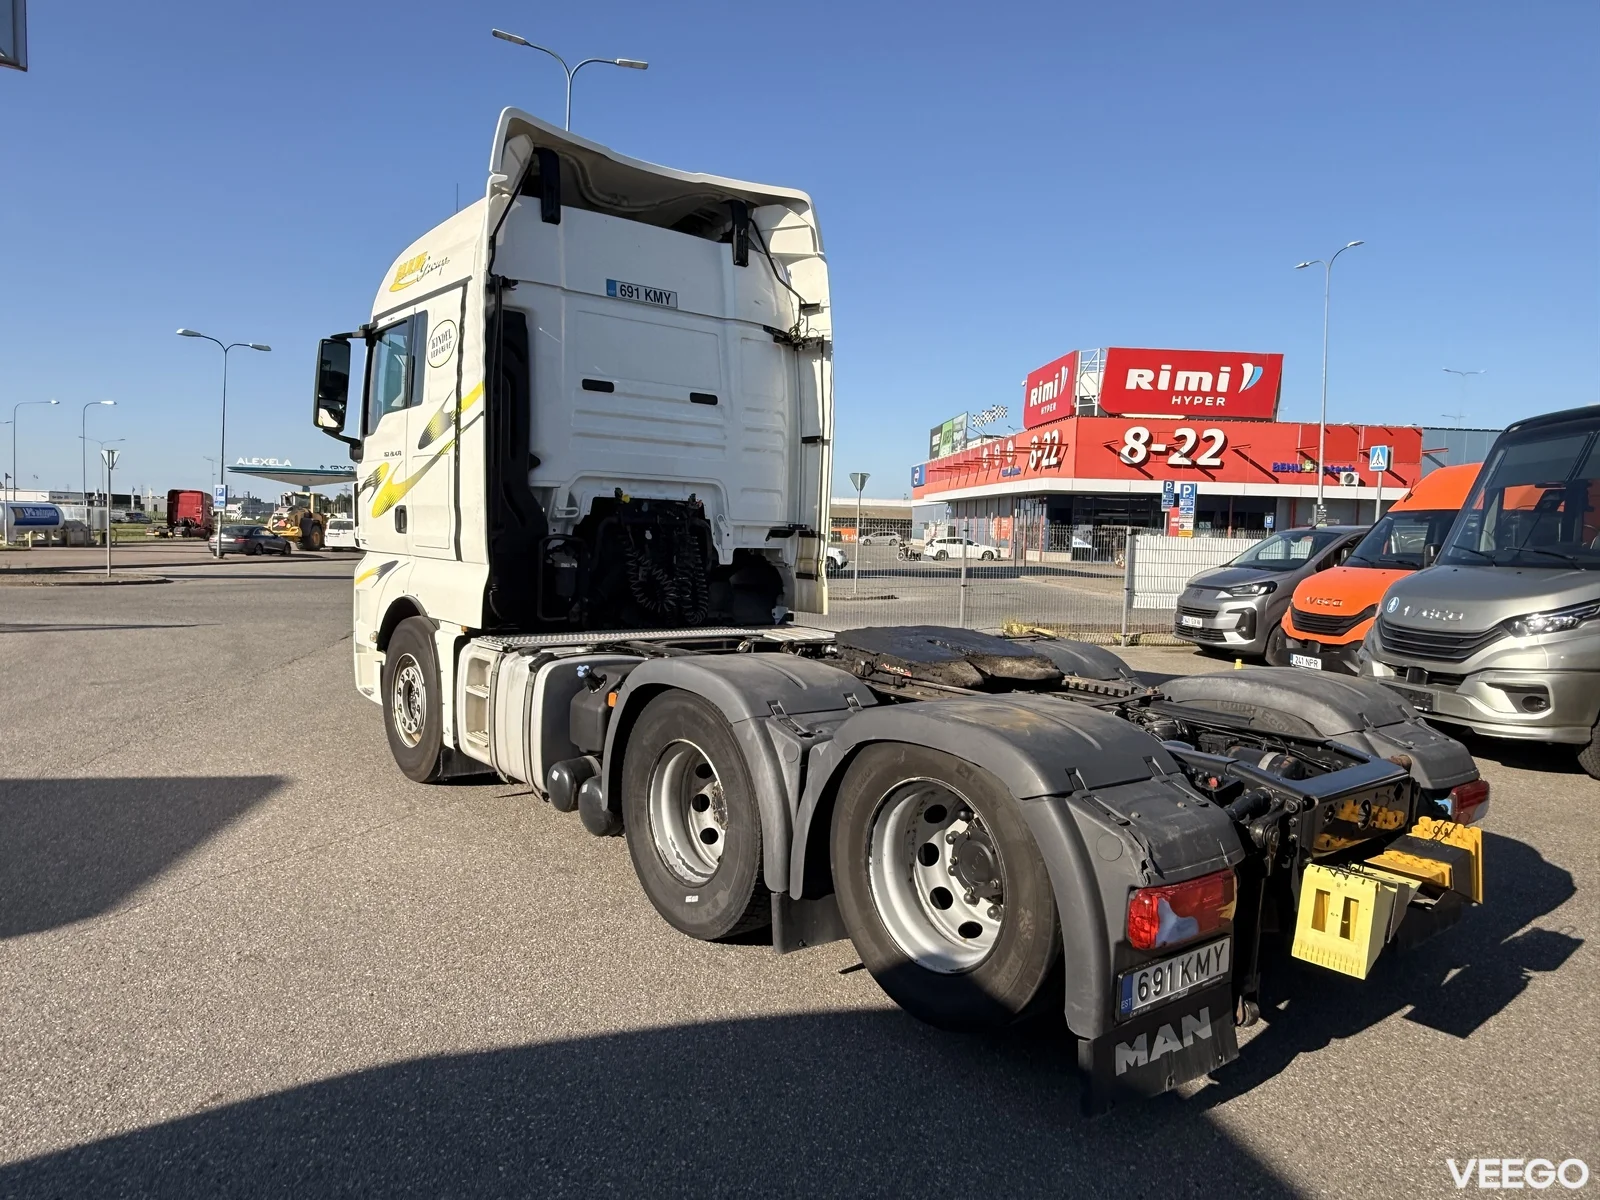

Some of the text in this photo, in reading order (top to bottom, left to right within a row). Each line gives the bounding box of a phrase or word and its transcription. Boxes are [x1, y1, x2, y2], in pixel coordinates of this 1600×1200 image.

[620, 284, 671, 305] 691 KMY
[1029, 373, 1059, 407] Rimi
[1125, 364, 1231, 392] Rimi
[1041, 402, 1056, 415] HYPER
[1171, 395, 1226, 406] HYPER
[1029, 429, 1059, 469] 8-22
[1120, 426, 1225, 466] 8-22
[236, 457, 292, 466] ALEXELA
[1295, 656, 1319, 667] 241 NPR
[1137, 943, 1225, 1002] 691 KMY
[1121, 998, 1132, 1010] EST
[1115, 1006, 1213, 1077] MAN
